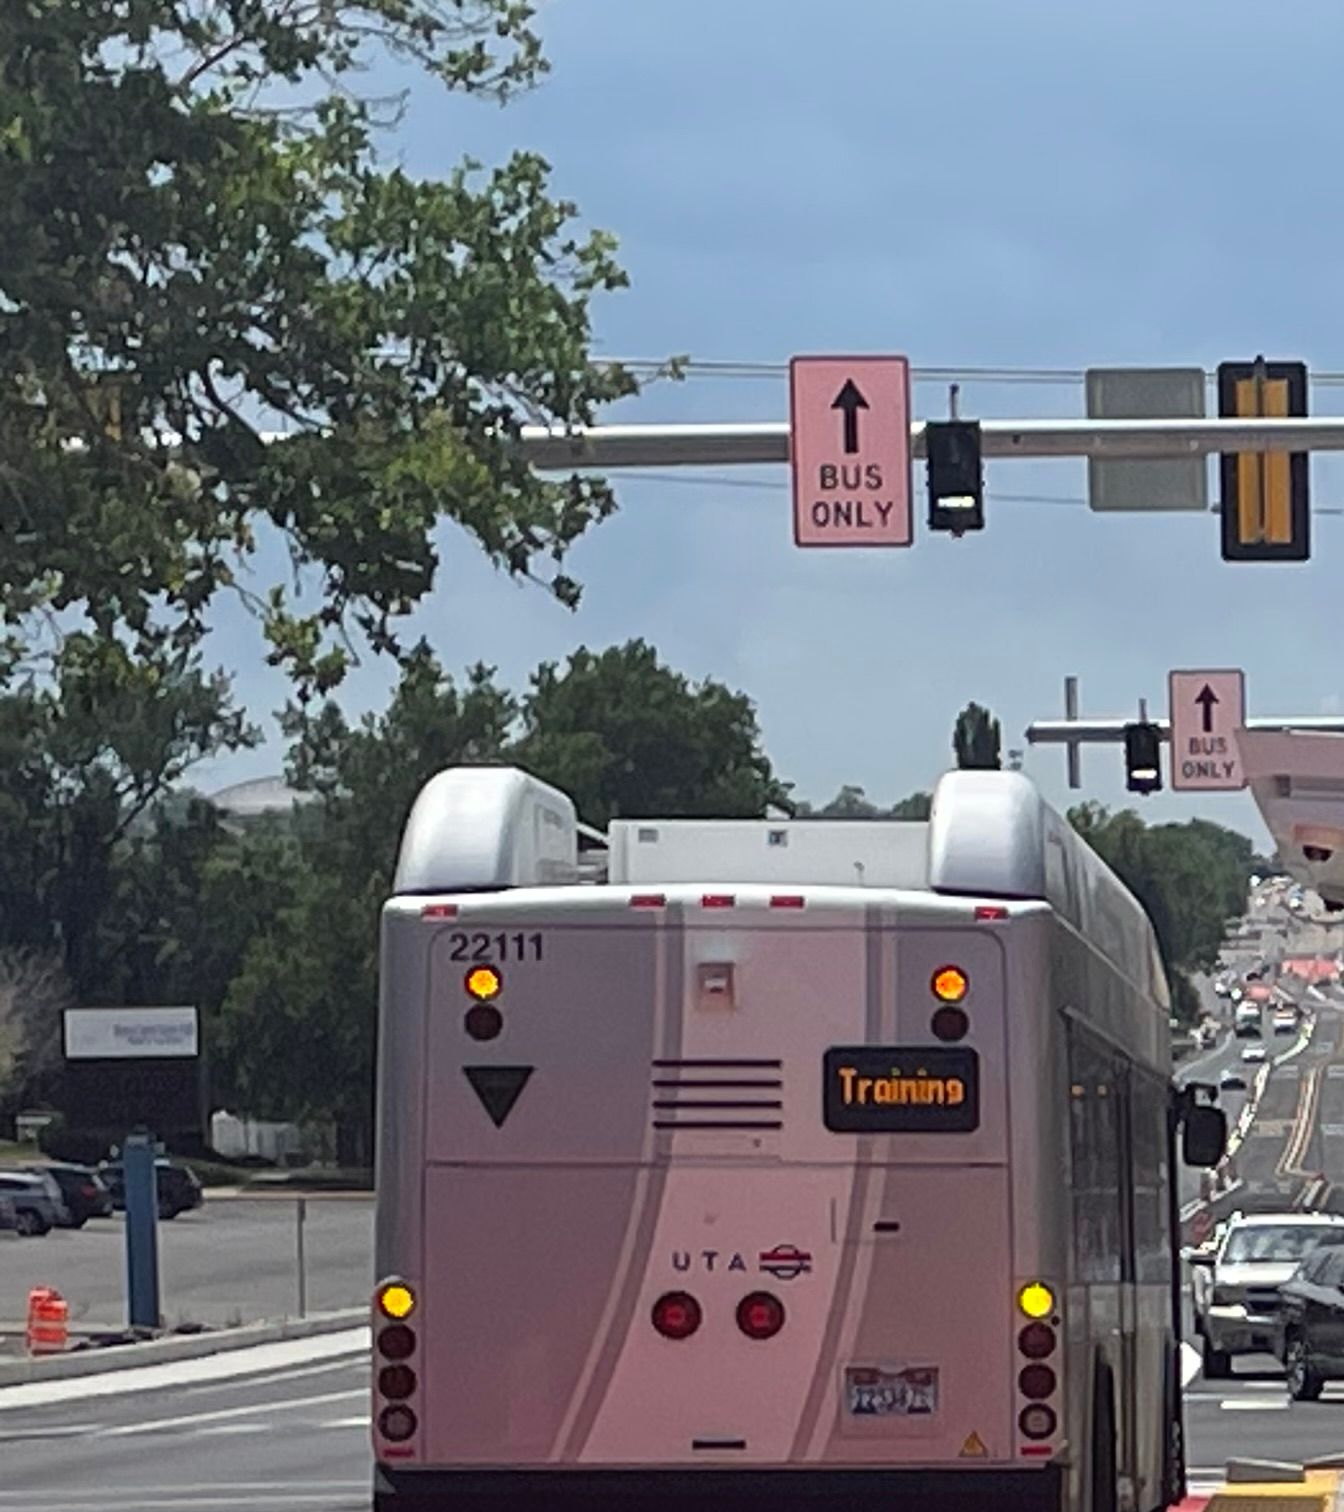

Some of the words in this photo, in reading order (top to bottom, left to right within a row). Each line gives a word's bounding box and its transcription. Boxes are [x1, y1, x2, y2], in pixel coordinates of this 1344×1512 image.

[819, 463, 883, 490] BUS
[812, 501, 893, 528] ONLY
[1189, 736, 1228, 756] BUS
[1182, 761, 1235, 779] ONLY
[450, 931, 543, 961] 22111
[837, 1065, 965, 1105] Training
[671, 1251, 747, 1272] UTA
